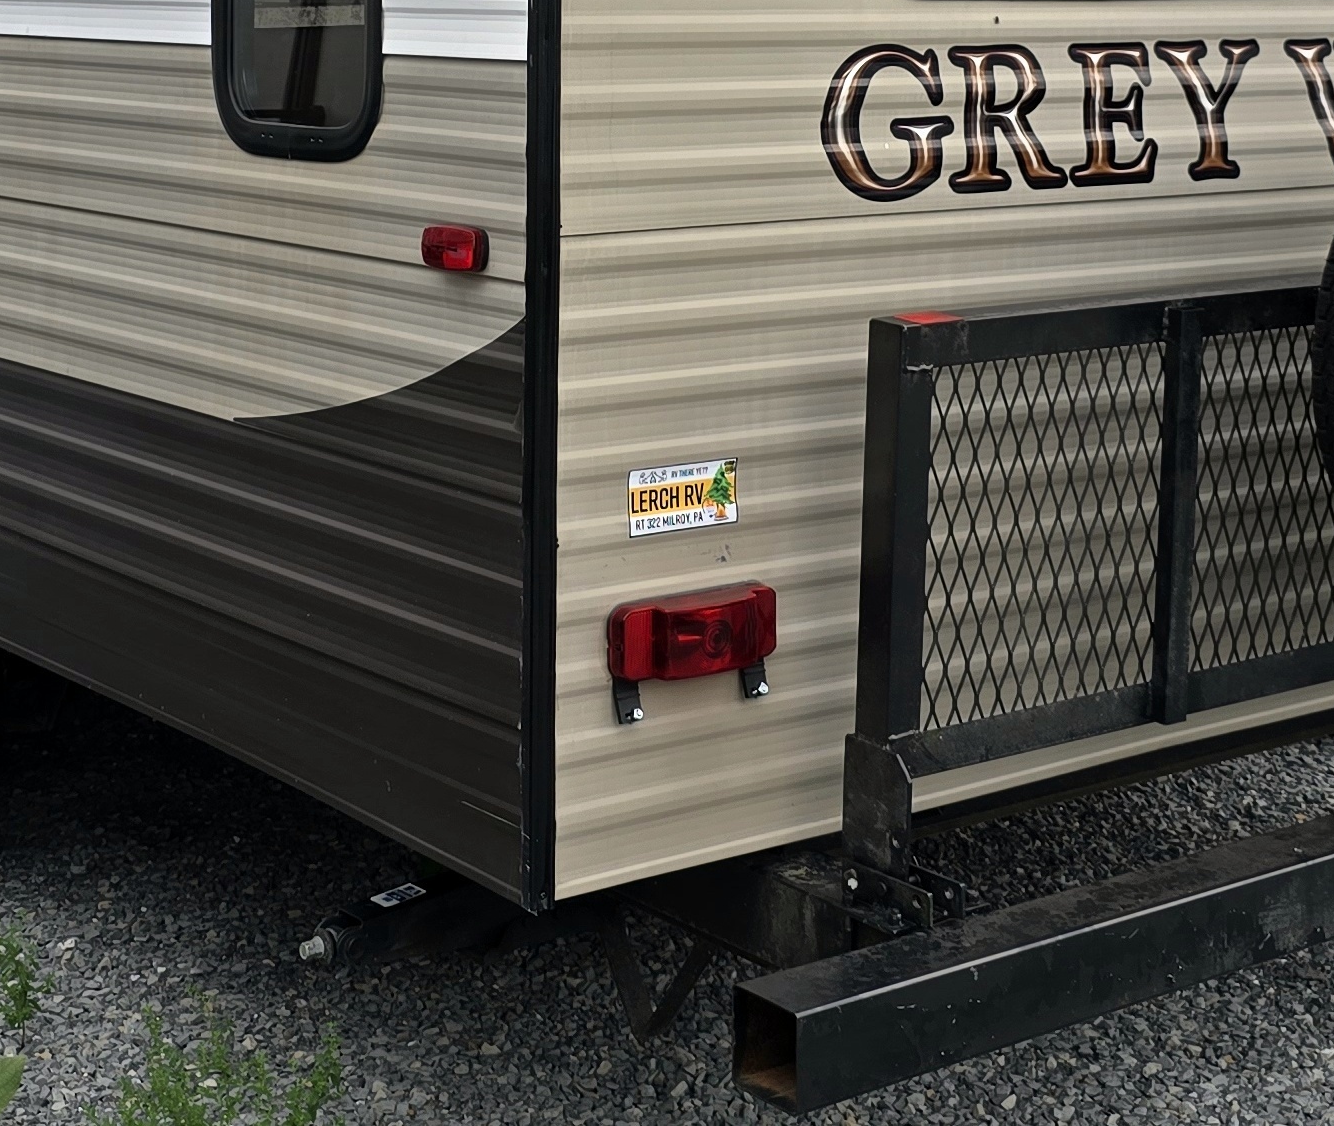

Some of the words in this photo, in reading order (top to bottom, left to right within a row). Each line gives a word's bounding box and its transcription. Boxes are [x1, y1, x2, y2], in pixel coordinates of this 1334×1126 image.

[820, 37, 1260, 202] GREY
[631, 485, 680, 514] LERCH
[684, 482, 704, 507] RV
[635, 518, 645, 531] RT
[647, 517, 661, 529] 322
[662, 514, 692, 528] MILROY,
[693, 511, 704, 523] PA
